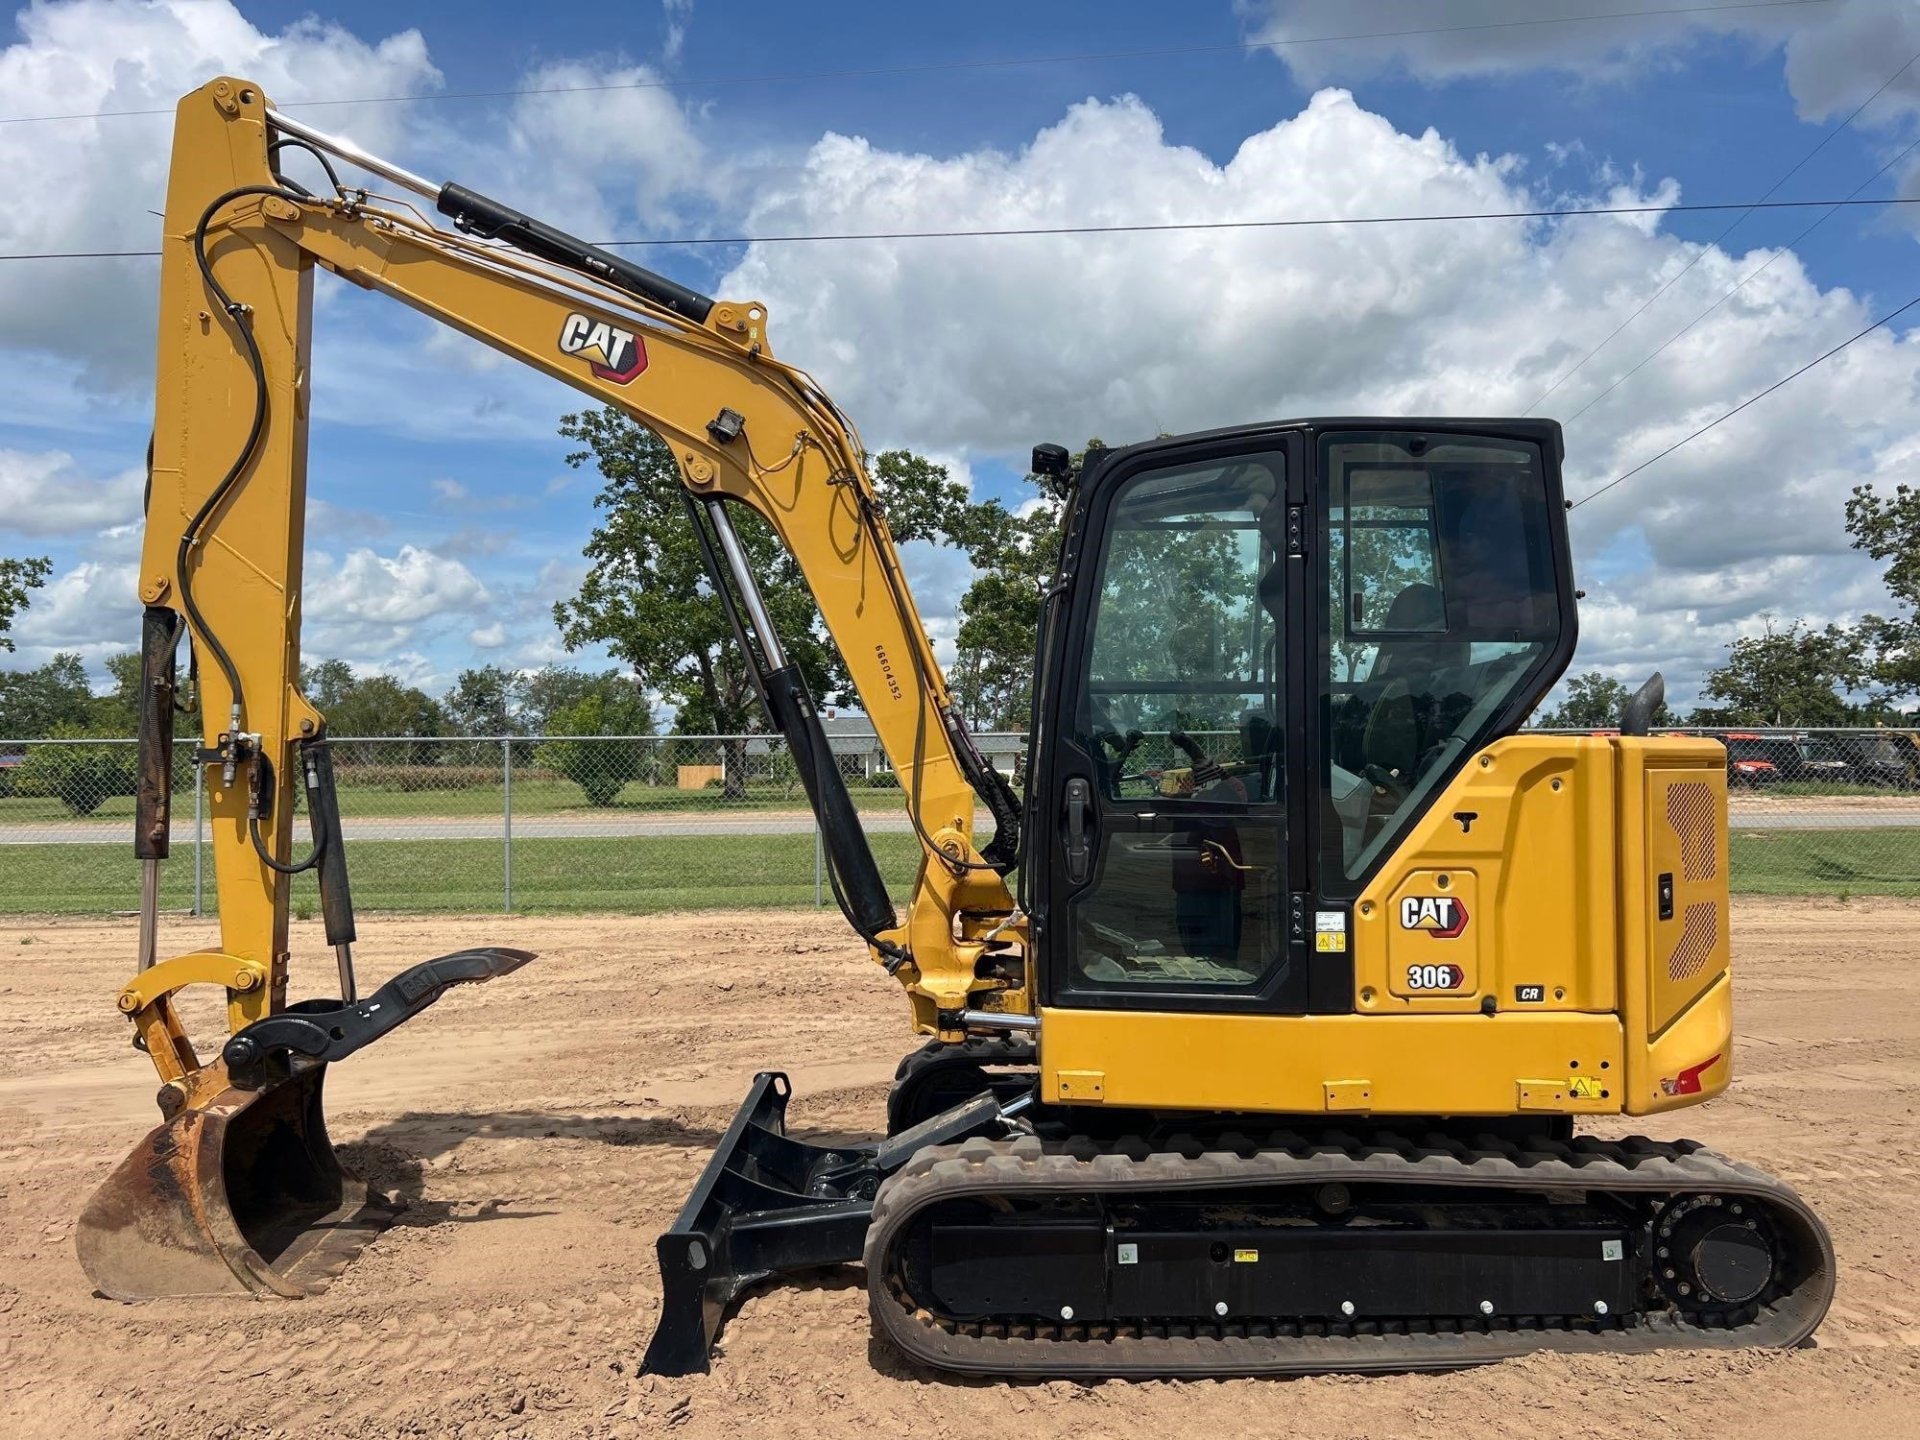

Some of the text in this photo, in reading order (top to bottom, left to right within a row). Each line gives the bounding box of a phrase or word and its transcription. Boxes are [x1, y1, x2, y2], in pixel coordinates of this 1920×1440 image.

[559, 313, 634, 370] CAT
[875, 644, 902, 701] 66604352
[1401, 897, 1453, 929] CAT
[1408, 965, 1451, 989] 306
[1521, 988, 1539, 1000] CR
